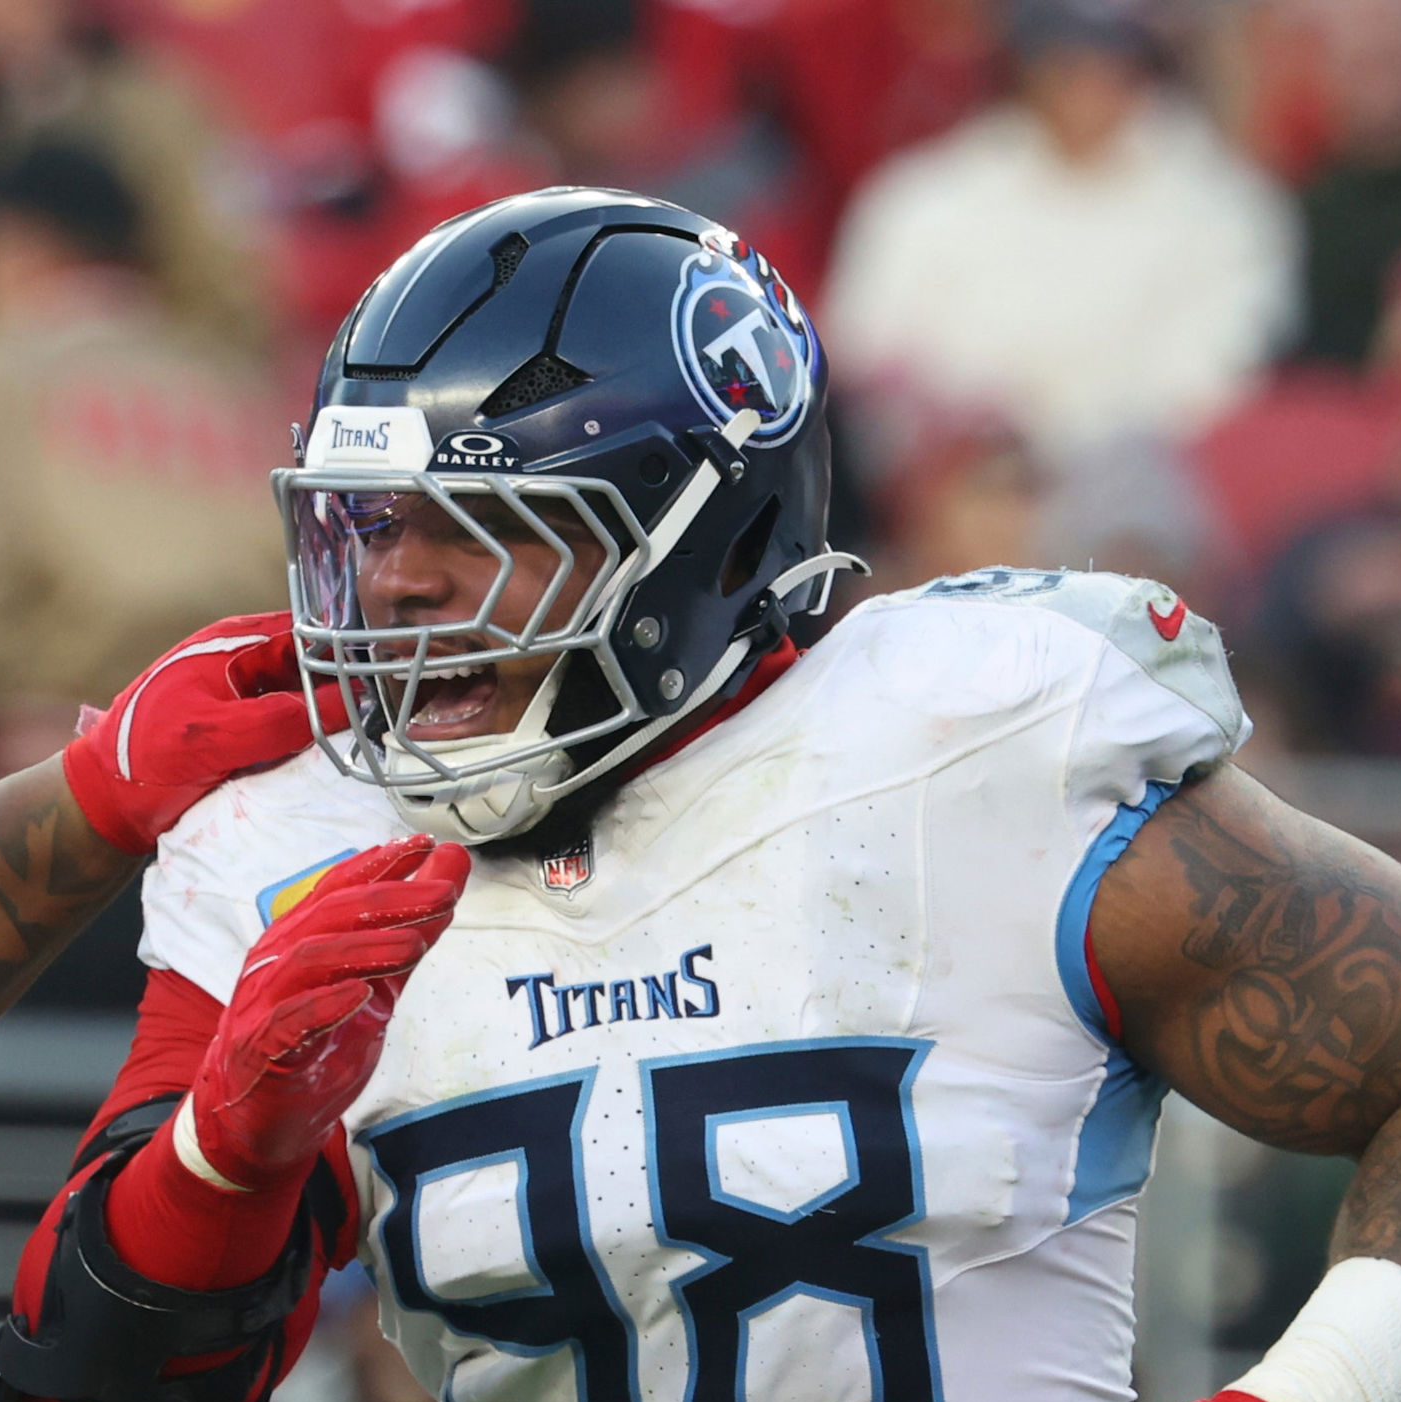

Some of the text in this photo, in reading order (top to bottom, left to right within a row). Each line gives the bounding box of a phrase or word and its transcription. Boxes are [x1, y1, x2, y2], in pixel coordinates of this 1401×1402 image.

[331, 419, 391, 451] TITANS
[437, 453, 516, 467] OAKLEY
[546, 856, 588, 886] NFL
[505, 944, 721, 1051] TITANS
